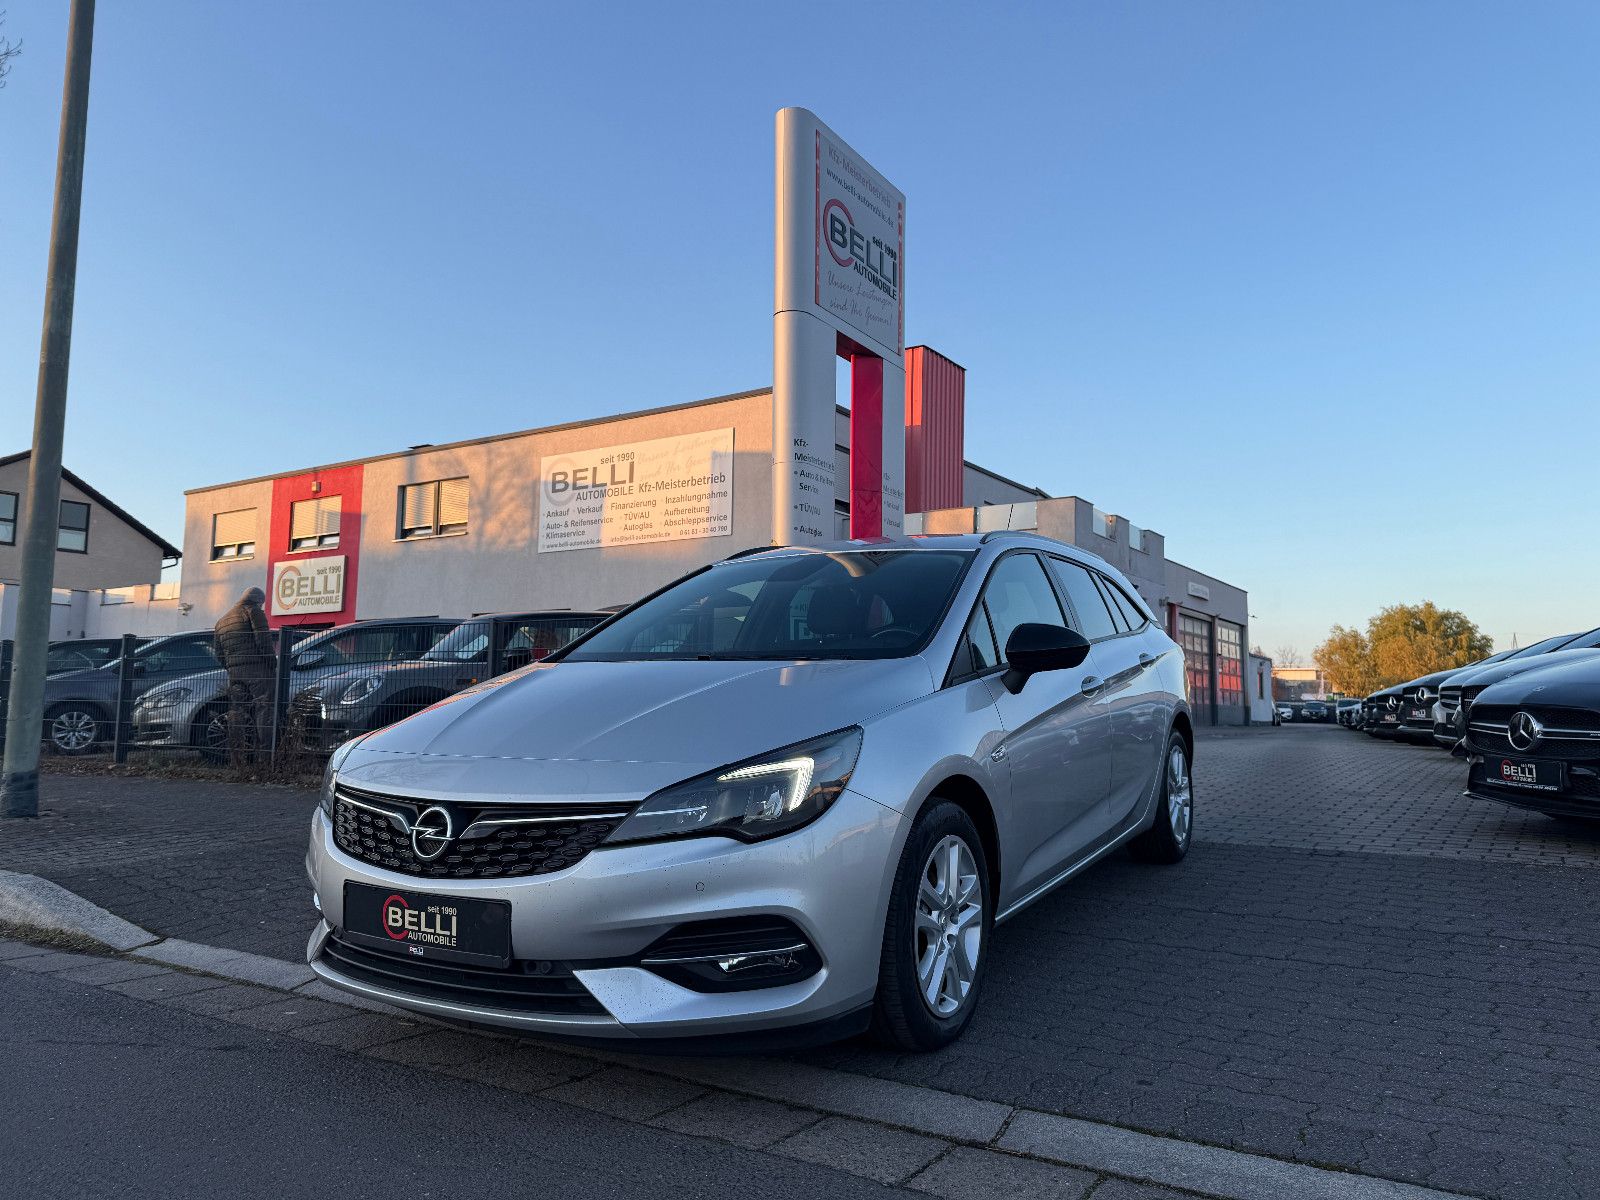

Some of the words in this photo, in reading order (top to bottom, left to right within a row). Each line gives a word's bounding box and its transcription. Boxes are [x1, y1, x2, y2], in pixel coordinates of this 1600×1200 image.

[828, 144, 891, 209] Kfz-Meisterbetrieb
[831, 213, 897, 288] BELLI
[872, 236, 884, 251] seit
[854, 261, 897, 301] AUTOMOBILE
[793, 438, 809, 448] Kfz-
[600, 454, 615, 465] seit
[617, 452, 635, 462] 1990
[551, 461, 635, 494] BELLI
[639, 472, 726, 493] Kfz-Meisterbetrieb
[546, 508, 570, 518] Ankauf
[577, 504, 603, 515] Verkauf
[610, 499, 657, 511] Finanzierung
[665, 490, 728, 504] Inzahlungnahme
[576, 486, 634, 502] AUTOMOBILE
[545, 530, 586, 540] Klimaservice
[623, 522, 653, 532] Autoglas
[663, 514, 728, 527] Abschleppservice
[570, 517, 614, 528] Reifenservice
[664, 506, 710, 517] Aufbereitung
[280, 573, 341, 598] BELLI
[298, 595, 340, 606] AUTOMOBILE
[1503, 765, 1536, 778] BELLI
[427, 905, 440, 914] seit
[441, 905, 457, 916] 1990
[388, 906, 457, 937] BELLI
[407, 930, 457, 947] AUTOMOBILE
